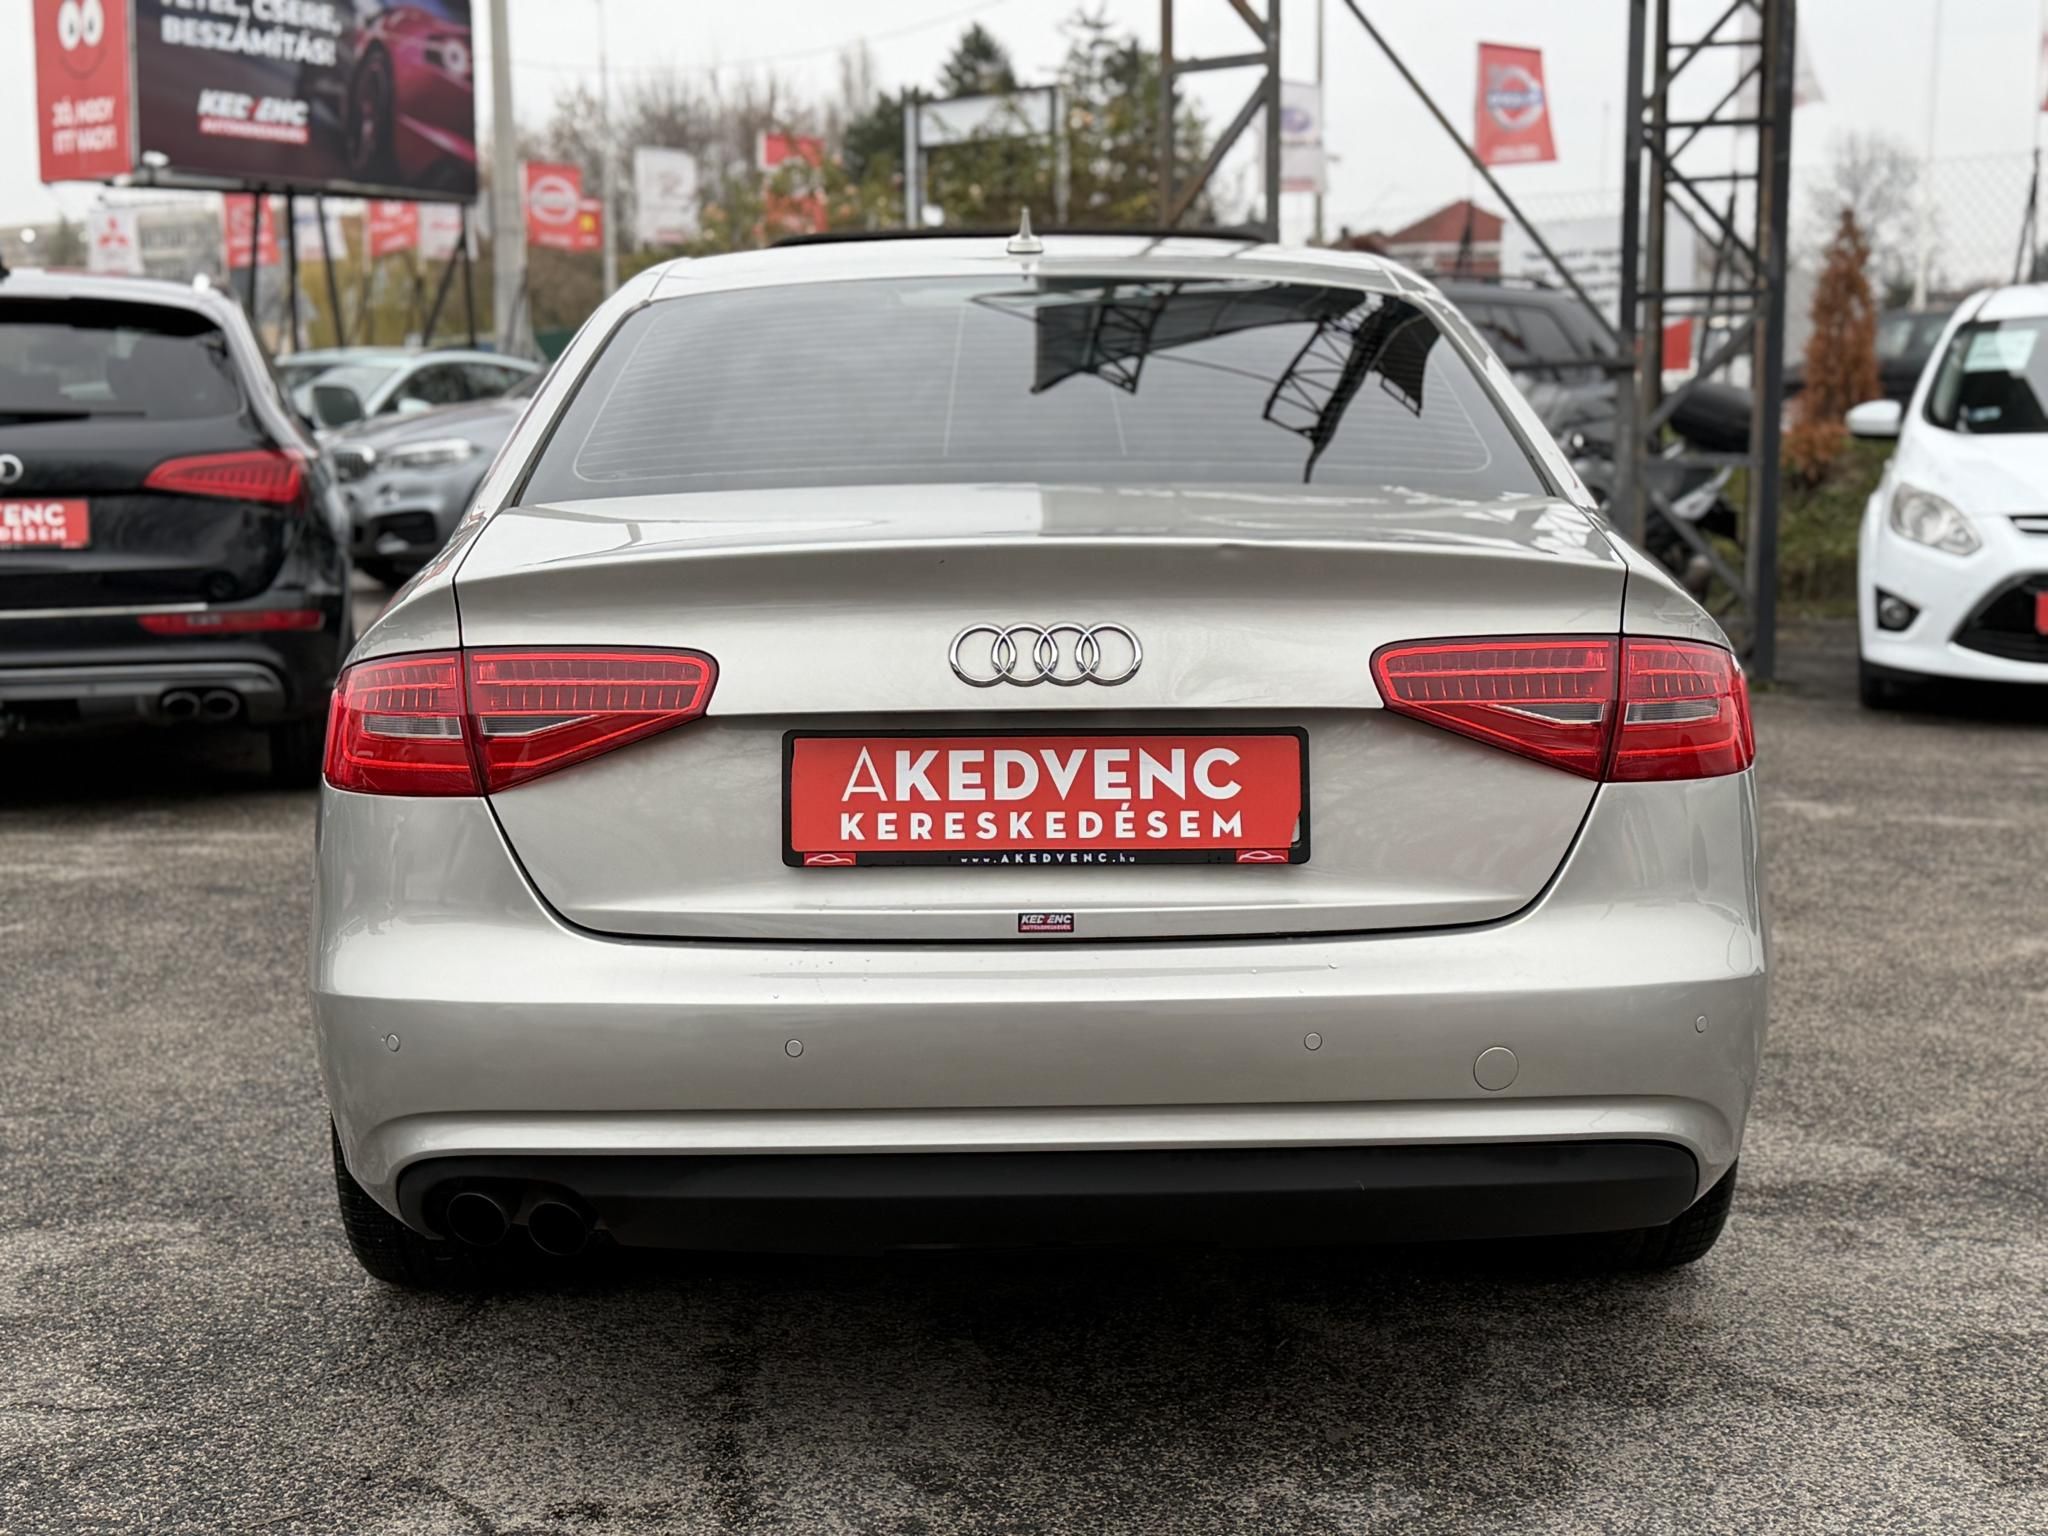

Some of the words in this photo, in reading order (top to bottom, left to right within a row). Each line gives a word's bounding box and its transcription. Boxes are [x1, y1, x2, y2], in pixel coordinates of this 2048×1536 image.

[0, 502, 66, 527] ENC
[841, 803, 1243, 841] KERESKEDÉSEM
[960, 853, 1136, 864] www.AKEDVENC.hu
